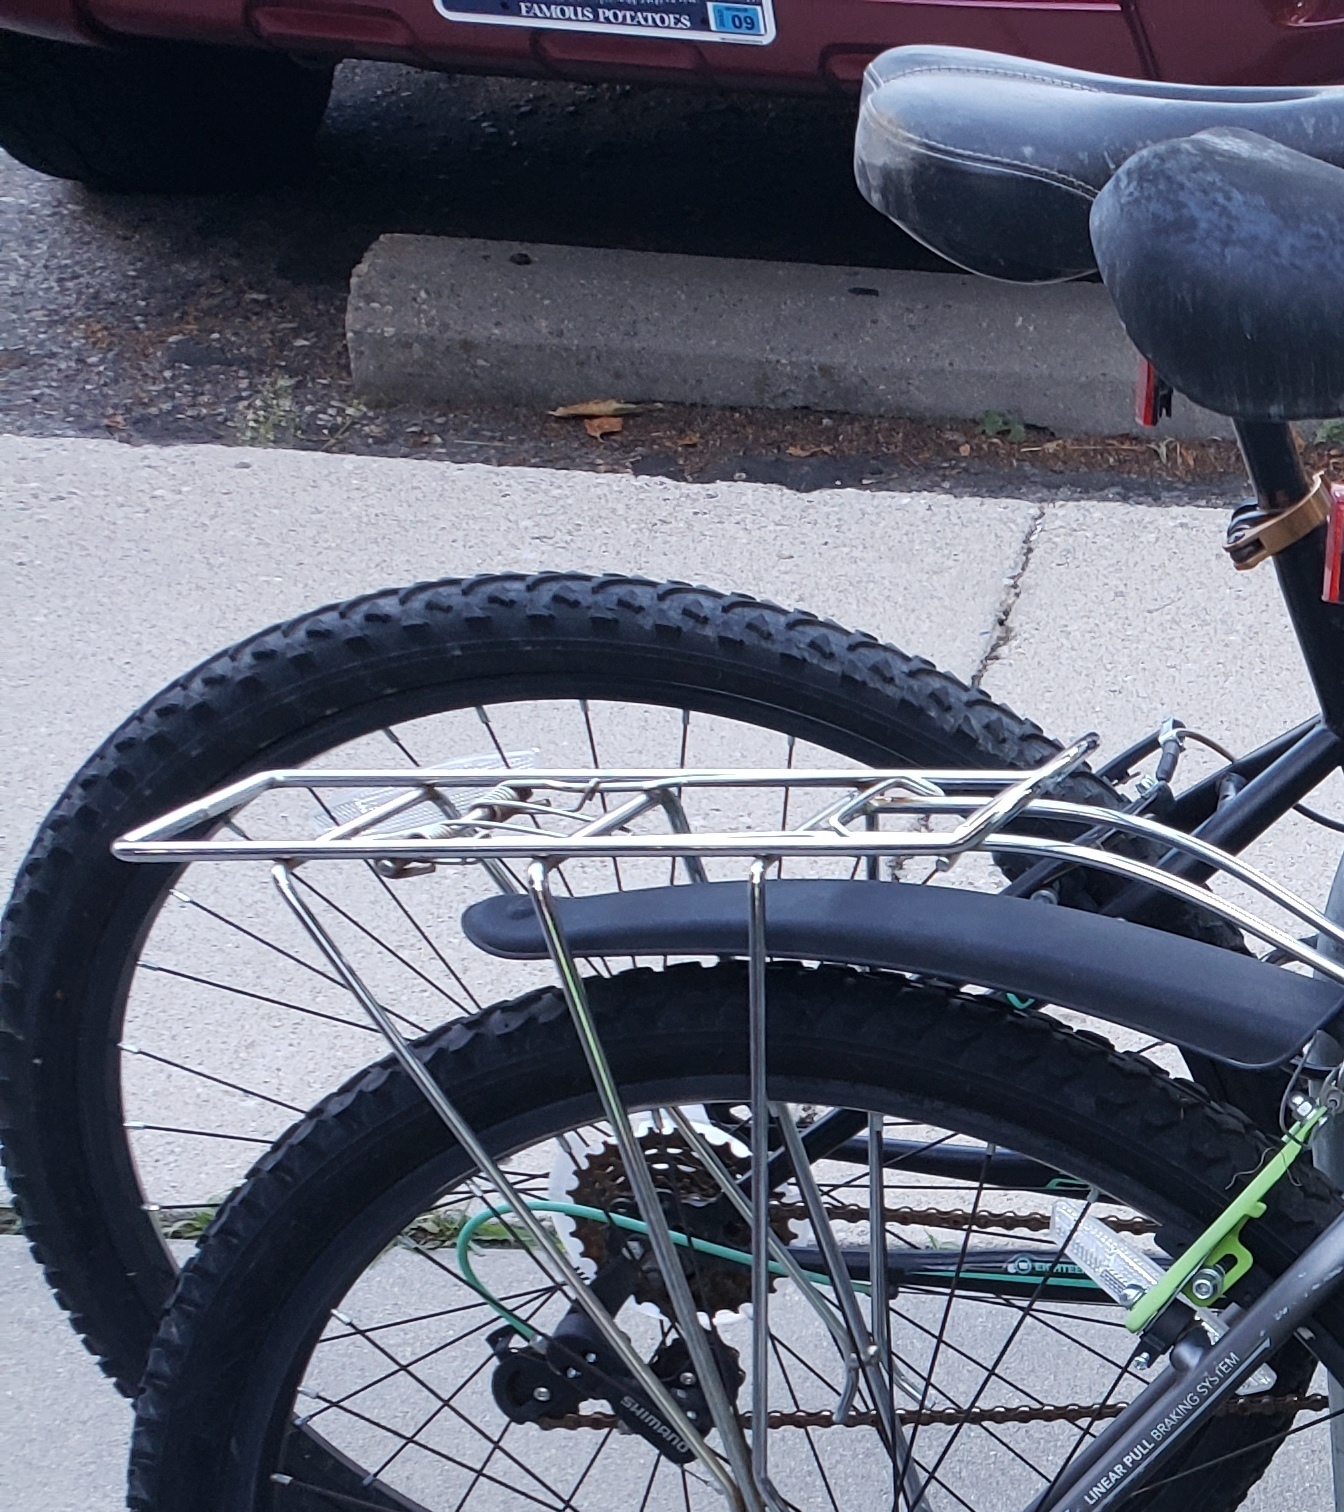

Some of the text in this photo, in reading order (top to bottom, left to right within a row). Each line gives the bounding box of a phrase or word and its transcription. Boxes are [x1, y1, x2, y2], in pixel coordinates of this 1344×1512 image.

[519, 2, 691, 28] FAMOUS POTATOES
[731, 14, 755, 30] 09
[620, 1396, 690, 1453] SHIMANO
[1084, 1351, 1240, 1505] LINEAR PULL BRAKING SYSTEM
